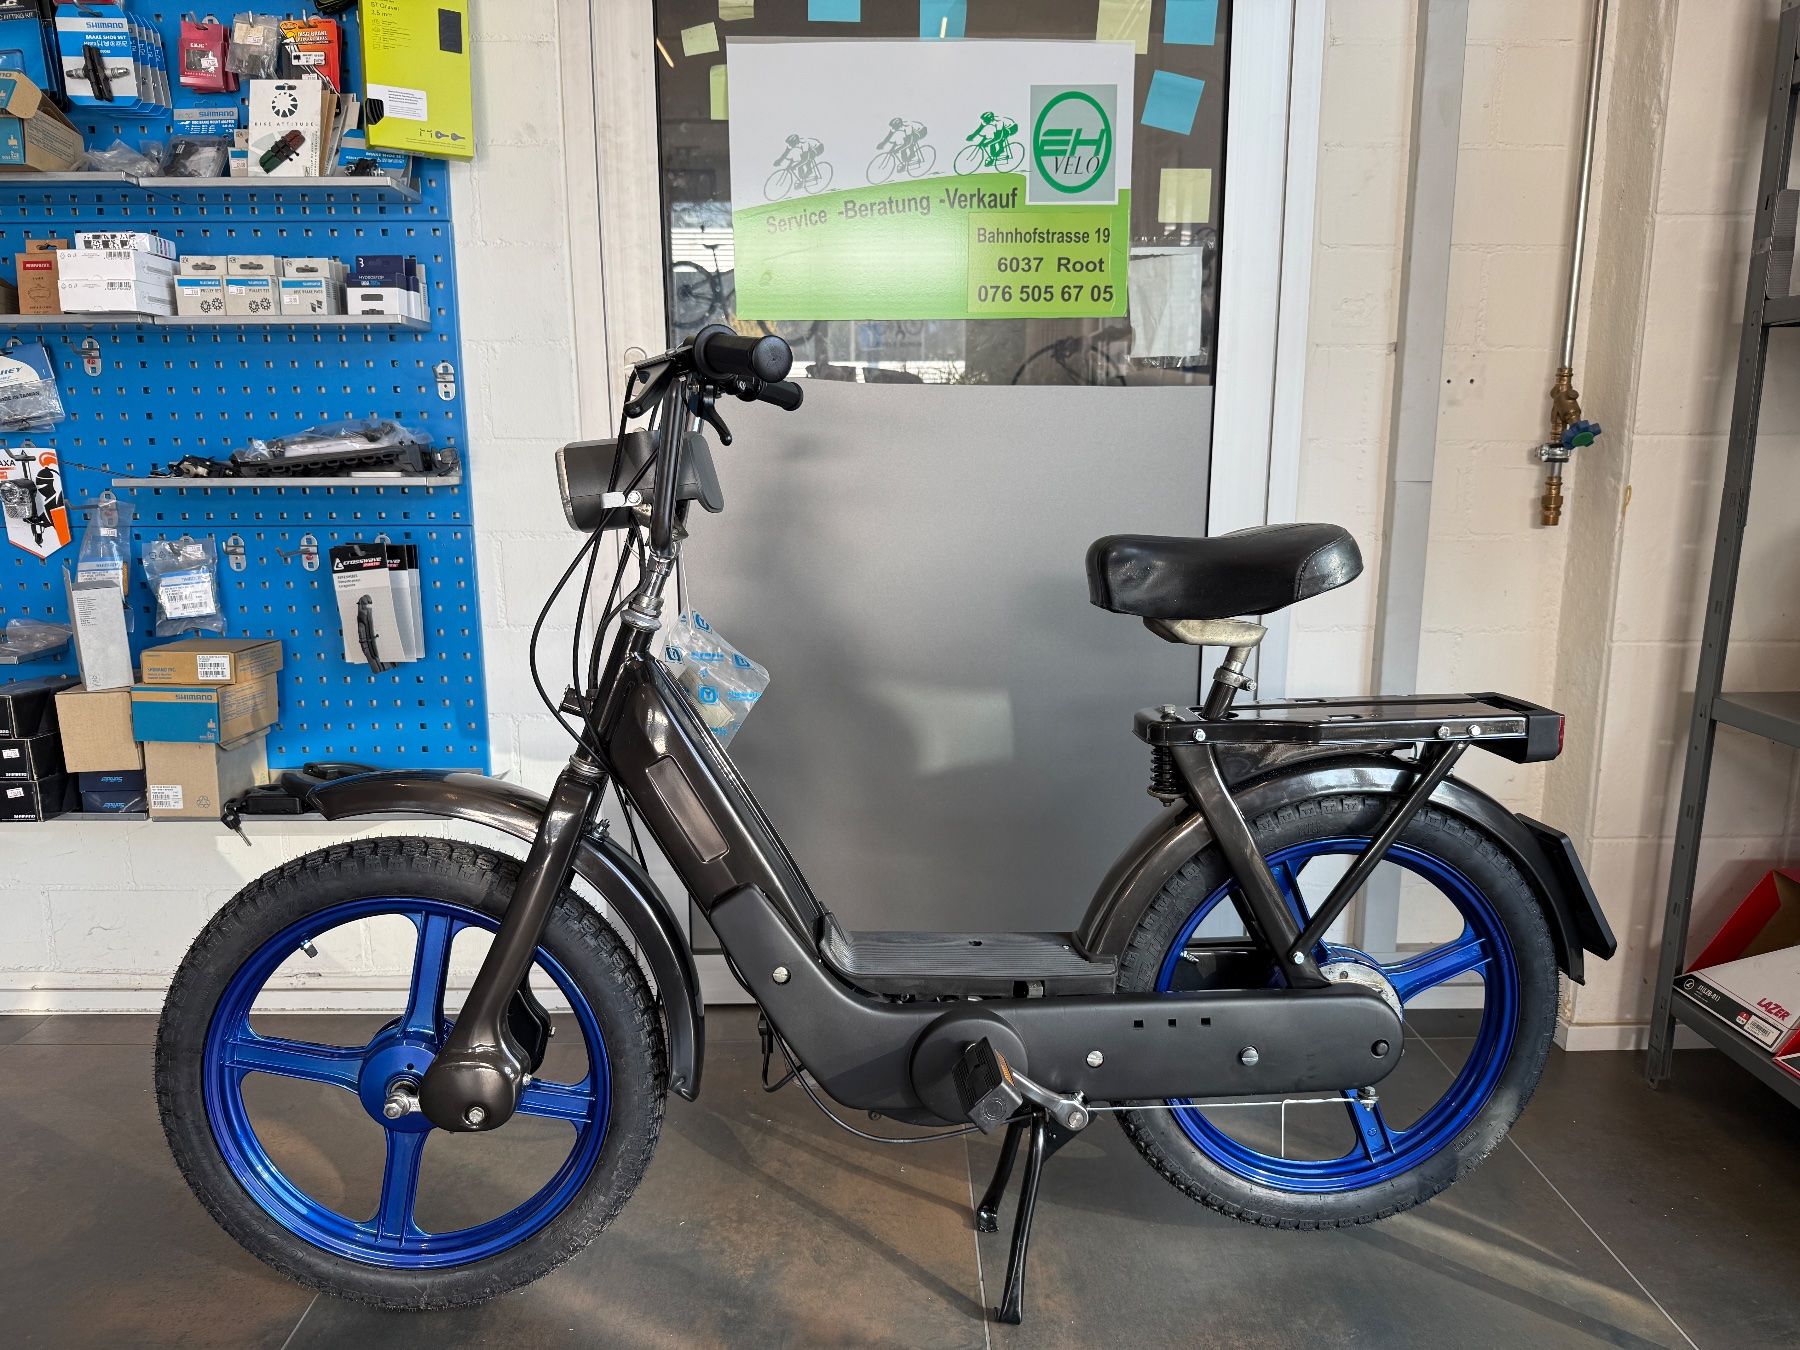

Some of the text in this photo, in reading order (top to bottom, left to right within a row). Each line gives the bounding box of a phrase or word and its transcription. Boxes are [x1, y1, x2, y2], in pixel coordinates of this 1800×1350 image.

[86, 21, 124, 29] SHIMANO
[1040, 128, 1106, 157] EH
[1054, 155, 1100, 175] VELO
[766, 187, 1018, 235] Service -Beratung -Verkauf
[977, 227, 1111, 244] Bahnhofstrasse 19
[997, 256, 1105, 273] 6037 Root
[977, 285, 1114, 303] 076 505 67 05
[20, 391, 40, 399] TAIWAN
[343, 556, 382, 566] crosswave
[1756, 997, 1791, 1021] LAZER
